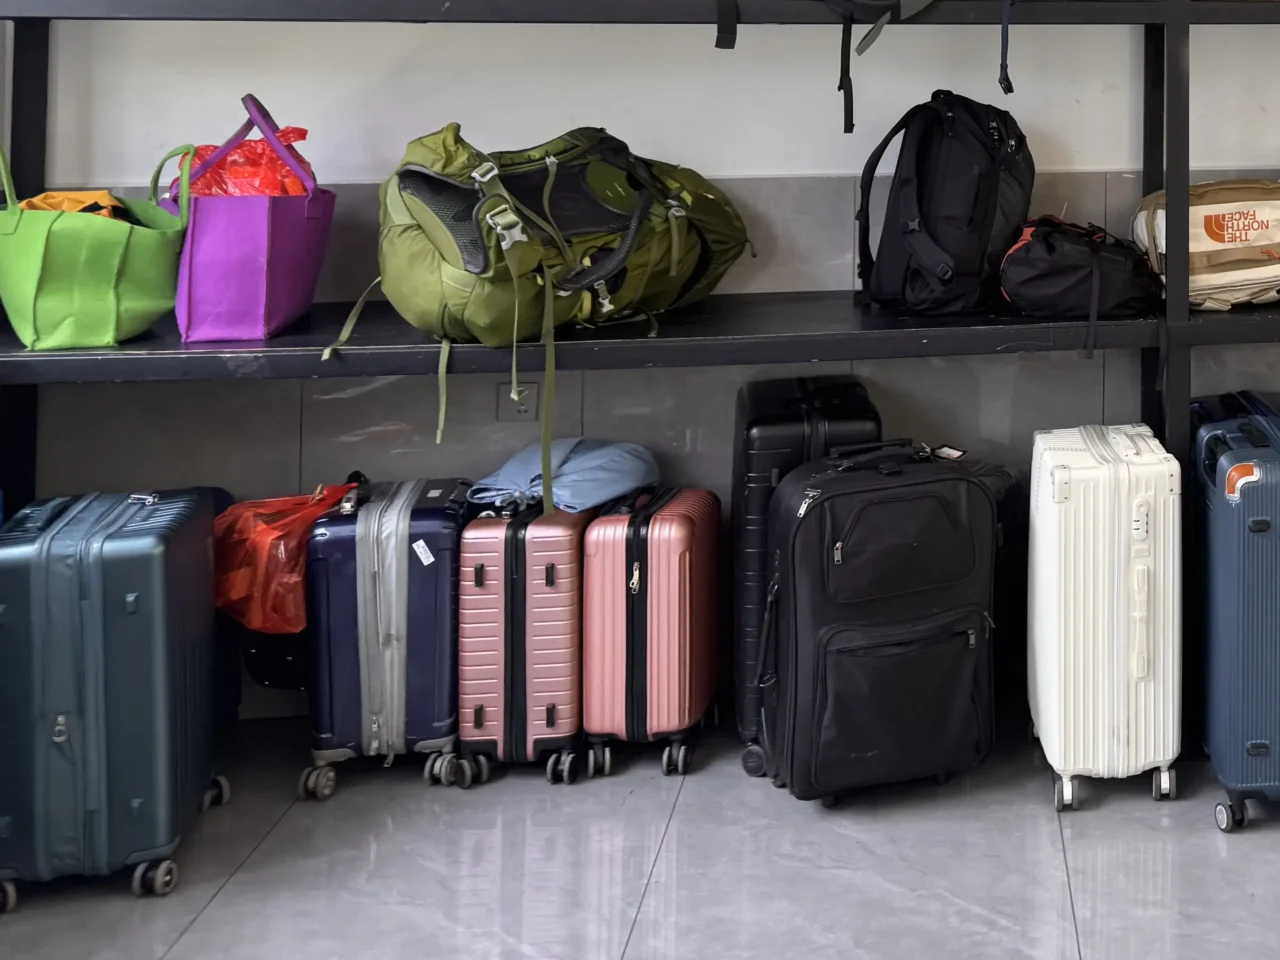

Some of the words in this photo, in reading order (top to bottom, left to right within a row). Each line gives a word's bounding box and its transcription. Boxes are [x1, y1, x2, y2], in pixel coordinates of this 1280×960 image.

[1226, 209, 1256, 222] FACE
[1226, 220, 1269, 232] NORTH
[1226, 231, 1251, 243] THE
